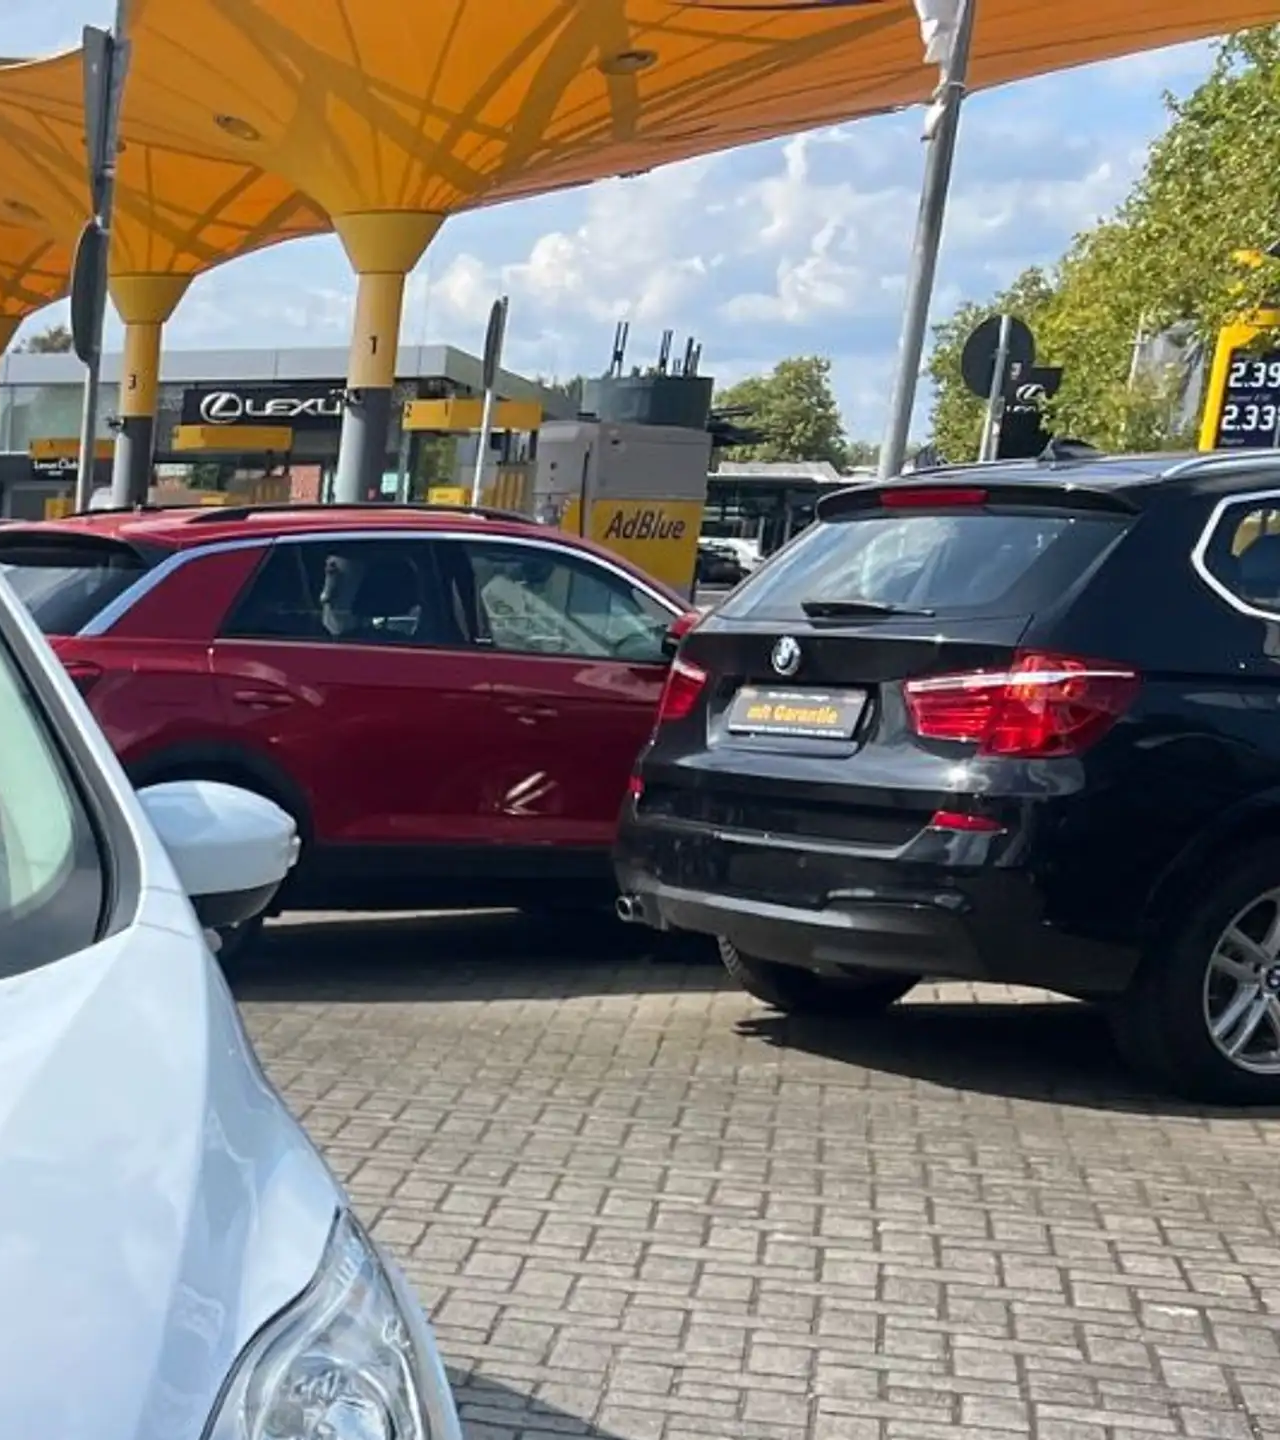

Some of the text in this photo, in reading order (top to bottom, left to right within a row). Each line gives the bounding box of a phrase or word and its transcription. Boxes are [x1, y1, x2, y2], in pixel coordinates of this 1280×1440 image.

[369, 335, 378, 355] 1
[128, 374, 137, 390] 3
[244, 398, 342, 417] LEXU
[603, 509, 686, 541] AdBlue
[774, 703, 839, 725] Garantie
